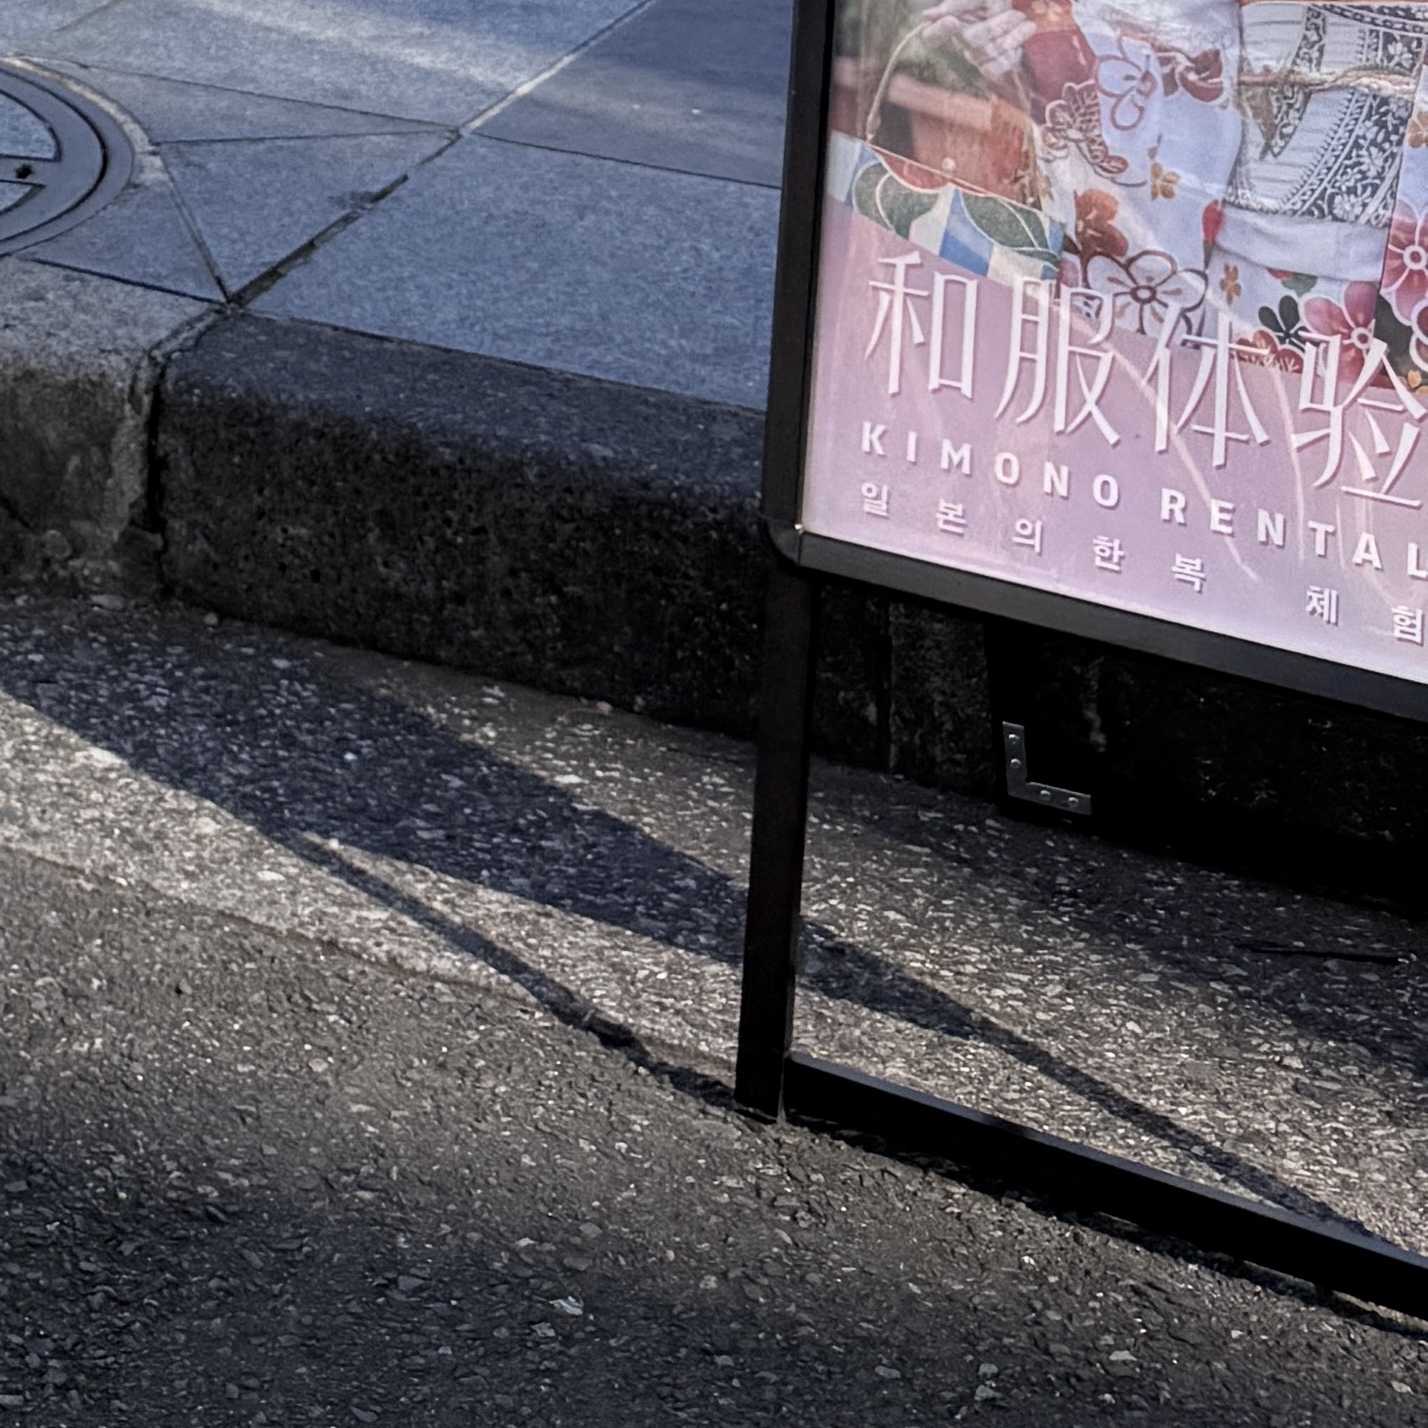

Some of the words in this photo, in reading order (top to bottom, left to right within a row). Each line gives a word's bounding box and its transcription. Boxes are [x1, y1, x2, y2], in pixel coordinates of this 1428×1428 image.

[864, 250, 1428, 508] 和服体验
[861, 421, 1120, 510] KIMONO
[1160, 488, 1428, 579] RENTAL
